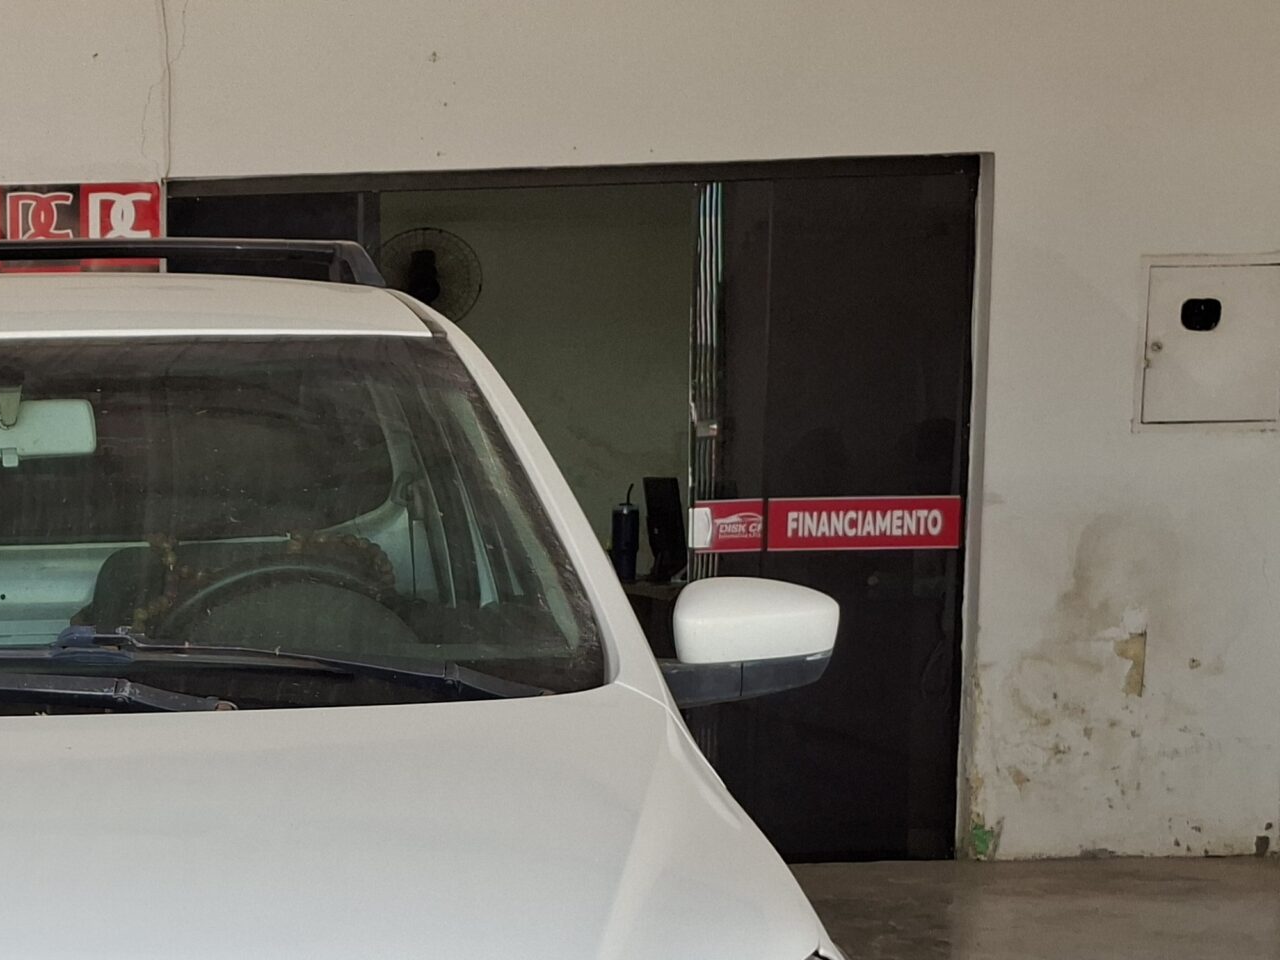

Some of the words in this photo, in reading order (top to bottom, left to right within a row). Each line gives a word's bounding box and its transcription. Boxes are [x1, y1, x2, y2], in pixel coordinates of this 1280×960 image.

[88, 191, 152, 239] DC
[719, 523, 747, 533] DISK
[786, 509, 942, 538] FINANCIAMENTO
